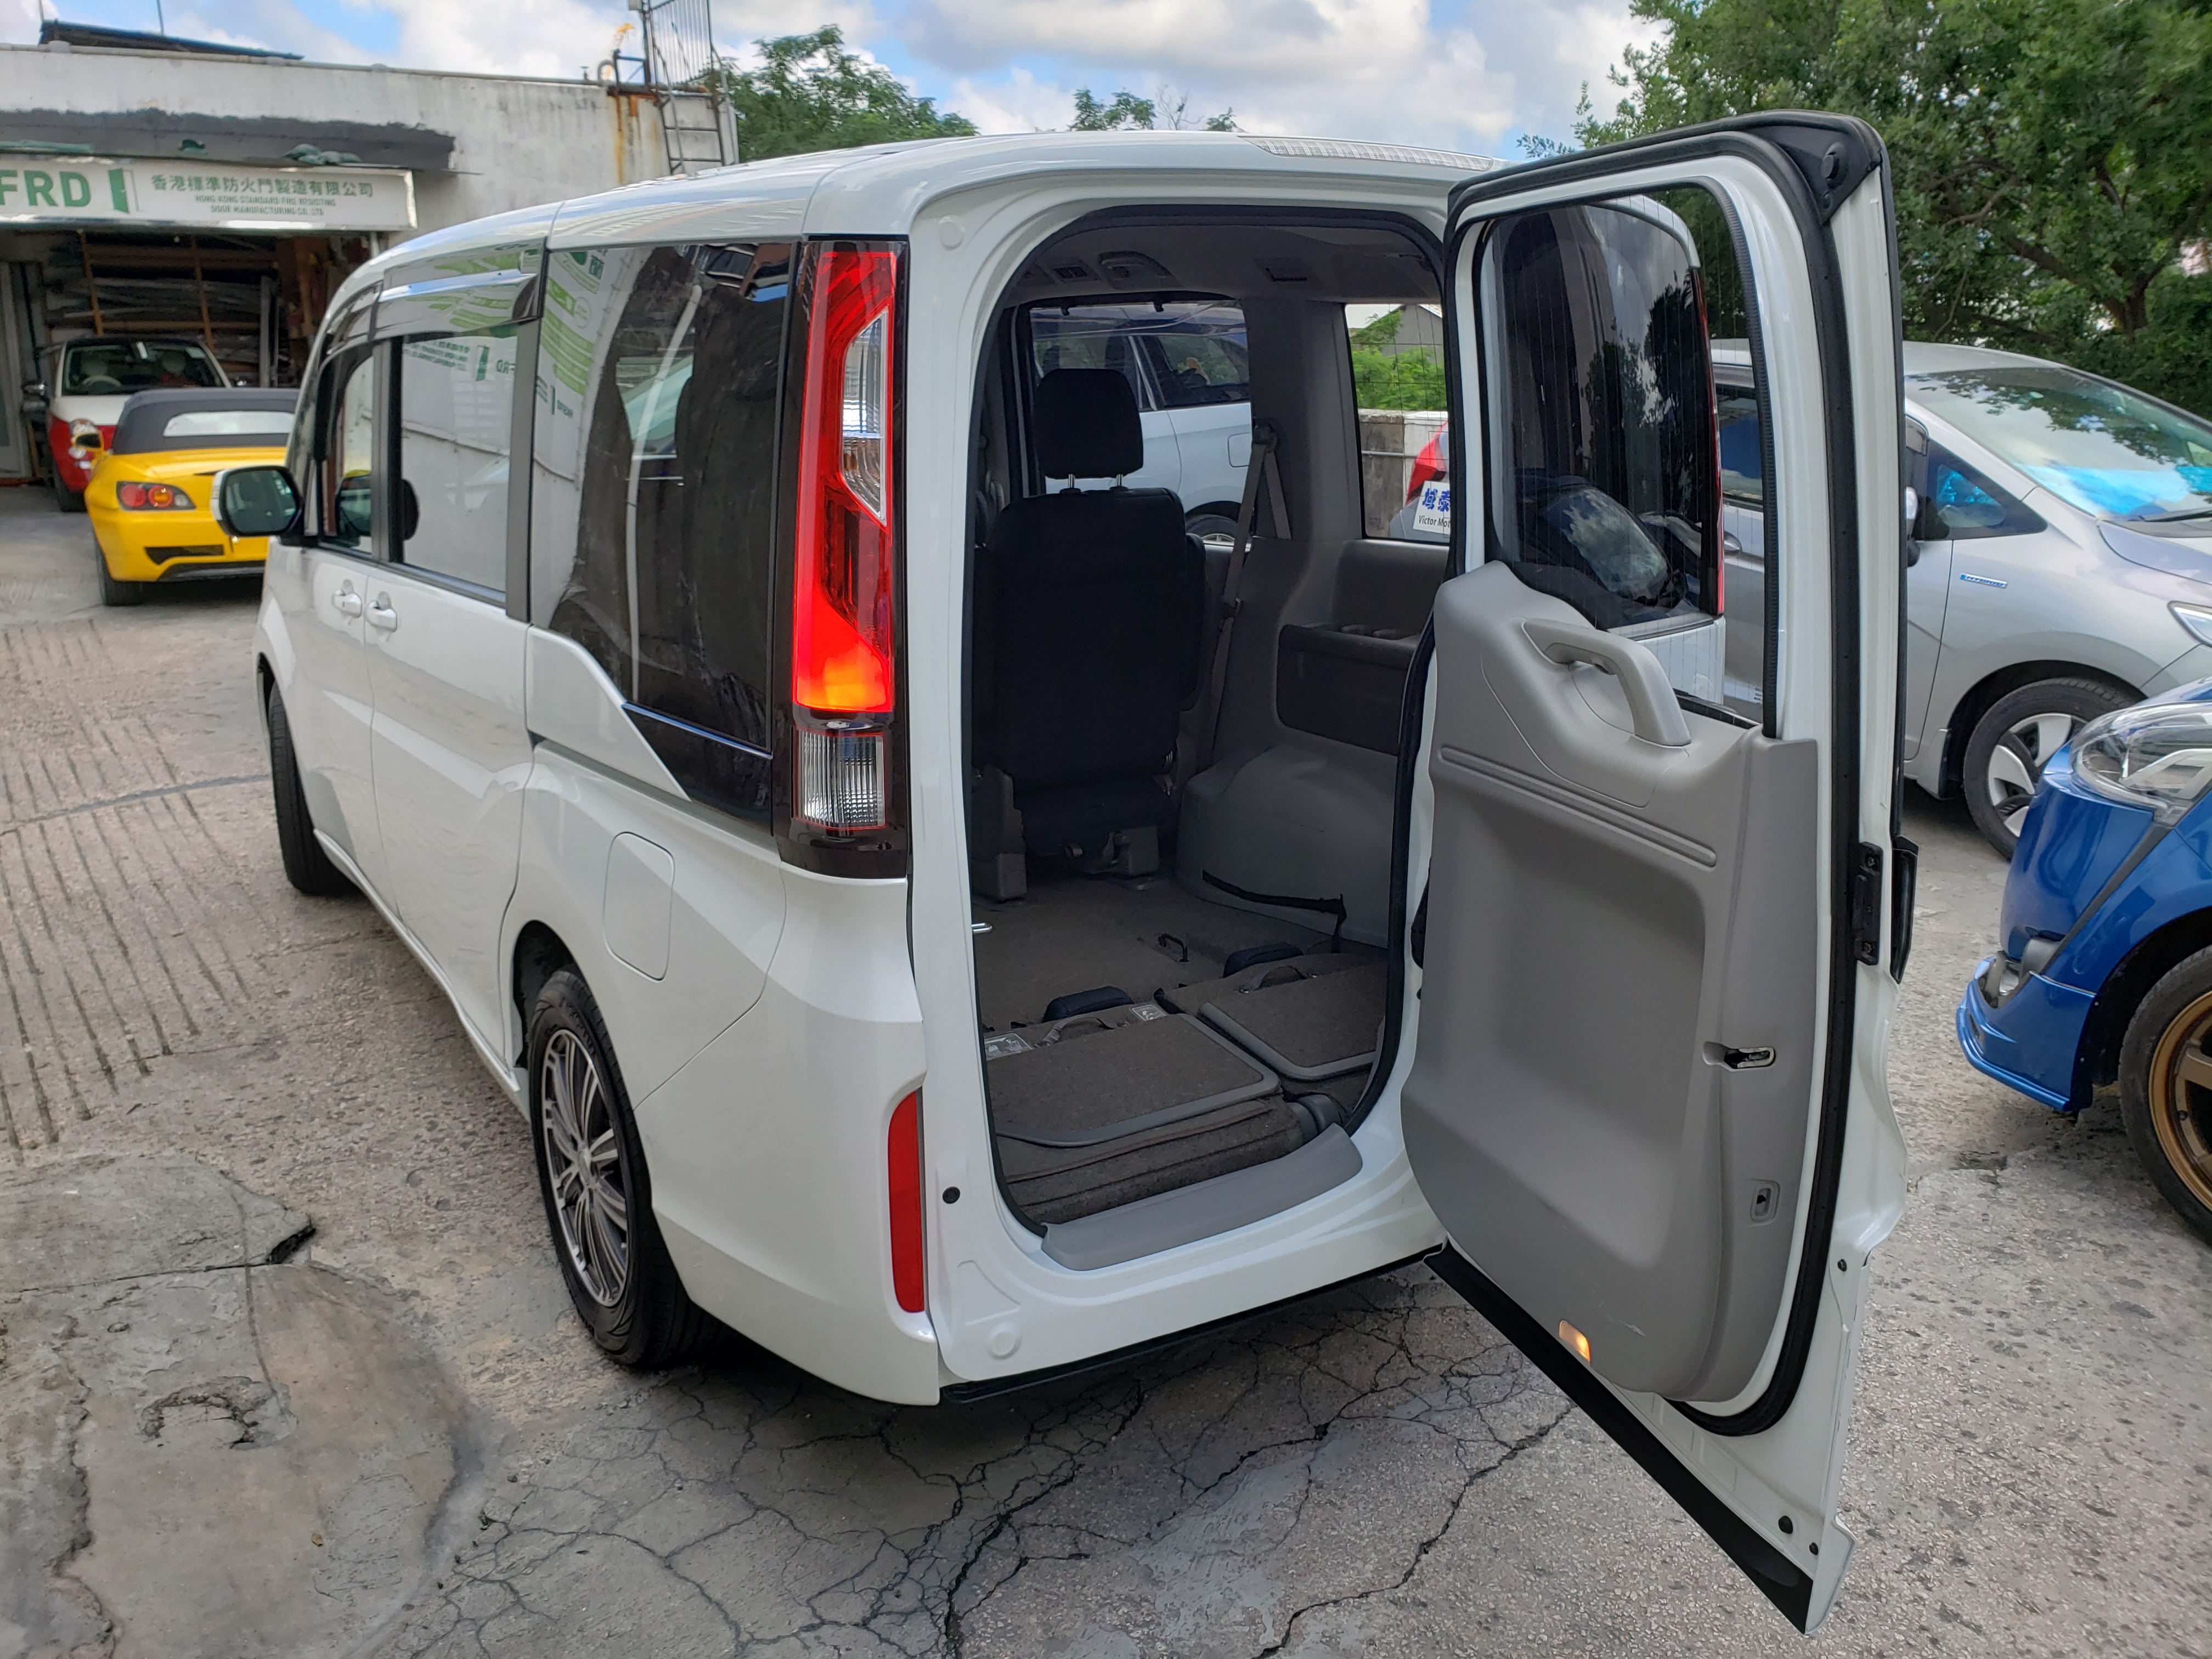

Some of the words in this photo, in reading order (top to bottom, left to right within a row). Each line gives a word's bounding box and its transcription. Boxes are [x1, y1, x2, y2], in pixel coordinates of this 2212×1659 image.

[0, 170, 91, 207] FRD
[151, 174, 374, 198] 香港標準防火門製造有限公司
[1419, 515, 1437, 526] Victor
